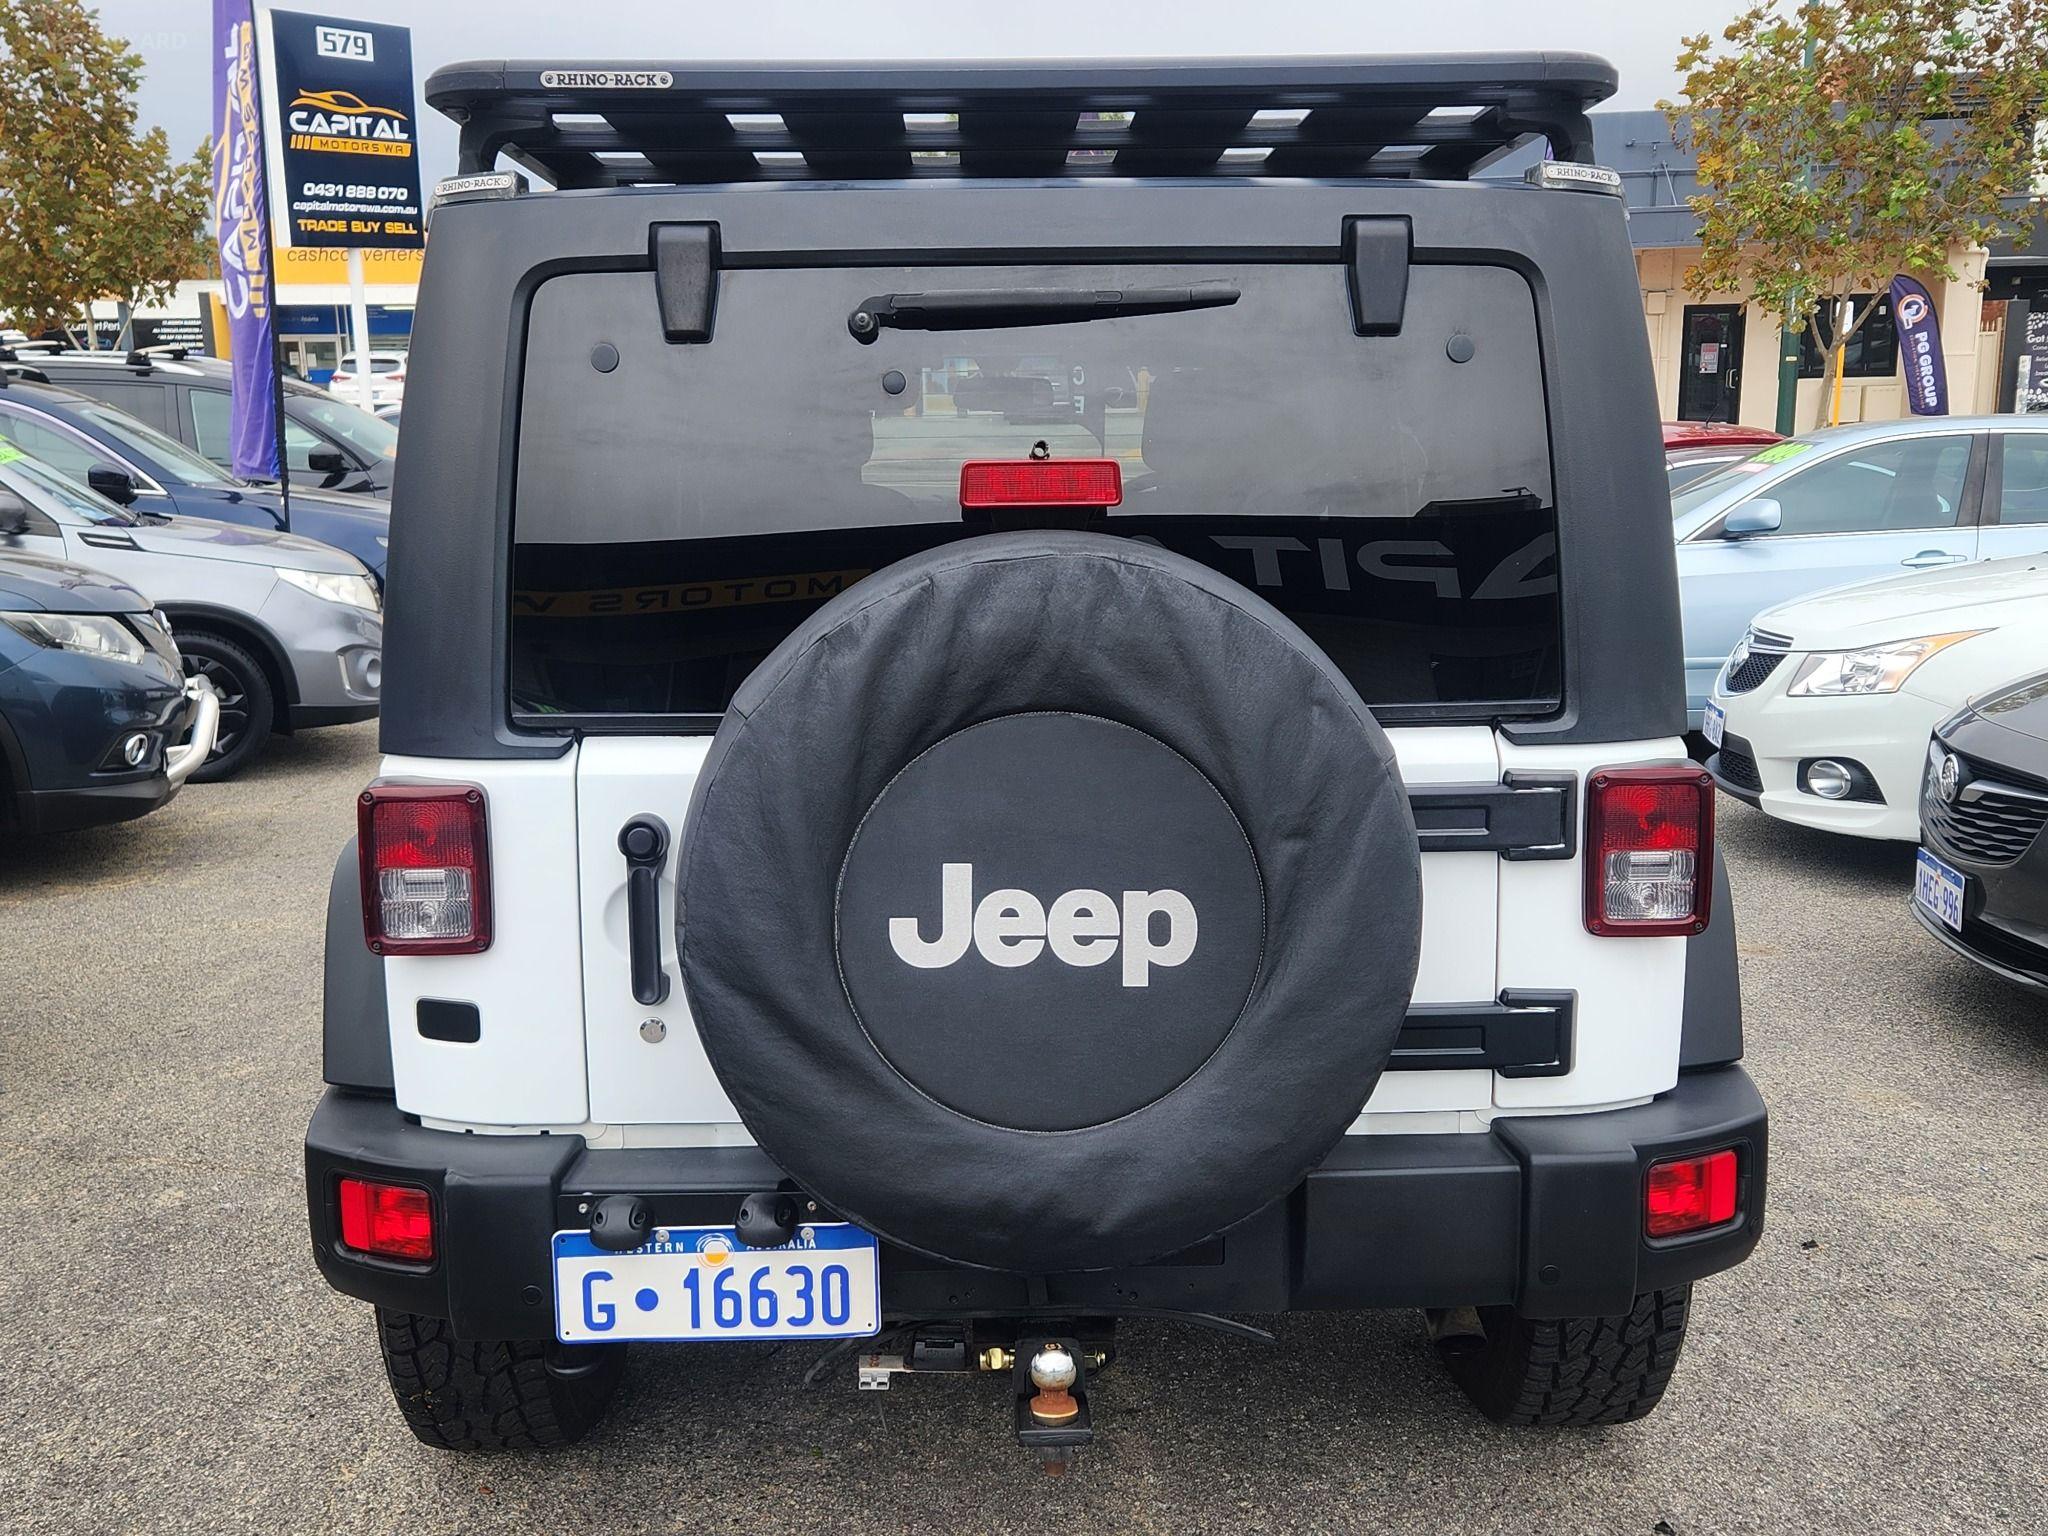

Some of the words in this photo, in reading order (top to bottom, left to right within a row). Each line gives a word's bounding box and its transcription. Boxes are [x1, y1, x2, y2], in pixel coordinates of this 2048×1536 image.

[323, 31, 367, 56] 579
[556, 73, 657, 86] RHINO-RACK
[289, 111, 409, 140] CAPITAL
[319, 138, 380, 153] MOTORS
[384, 143, 404, 154] WA
[1556, 167, 1613, 182] RHINO-RACK
[303, 182, 344, 198] 0431
[345, 184, 376, 199] 888
[377, 186, 408, 200] 070
[442, 178, 501, 192] RHINO-RACK
[293, 200, 418, 215] capitalmotorswa.com.au
[297, 218, 348, 233] TRADE
[351, 220, 381, 234] BUY
[385, 222, 418, 235] SELL
[287, 248, 424, 262] cashcoverters
[1920, 354, 1938, 407] GROUP
[889, 863, 1198, 987] Jeep
[614, 1242, 684, 1255] STERN
[582, 1270, 616, 1332] G
[683, 1264, 850, 1329] 16630
